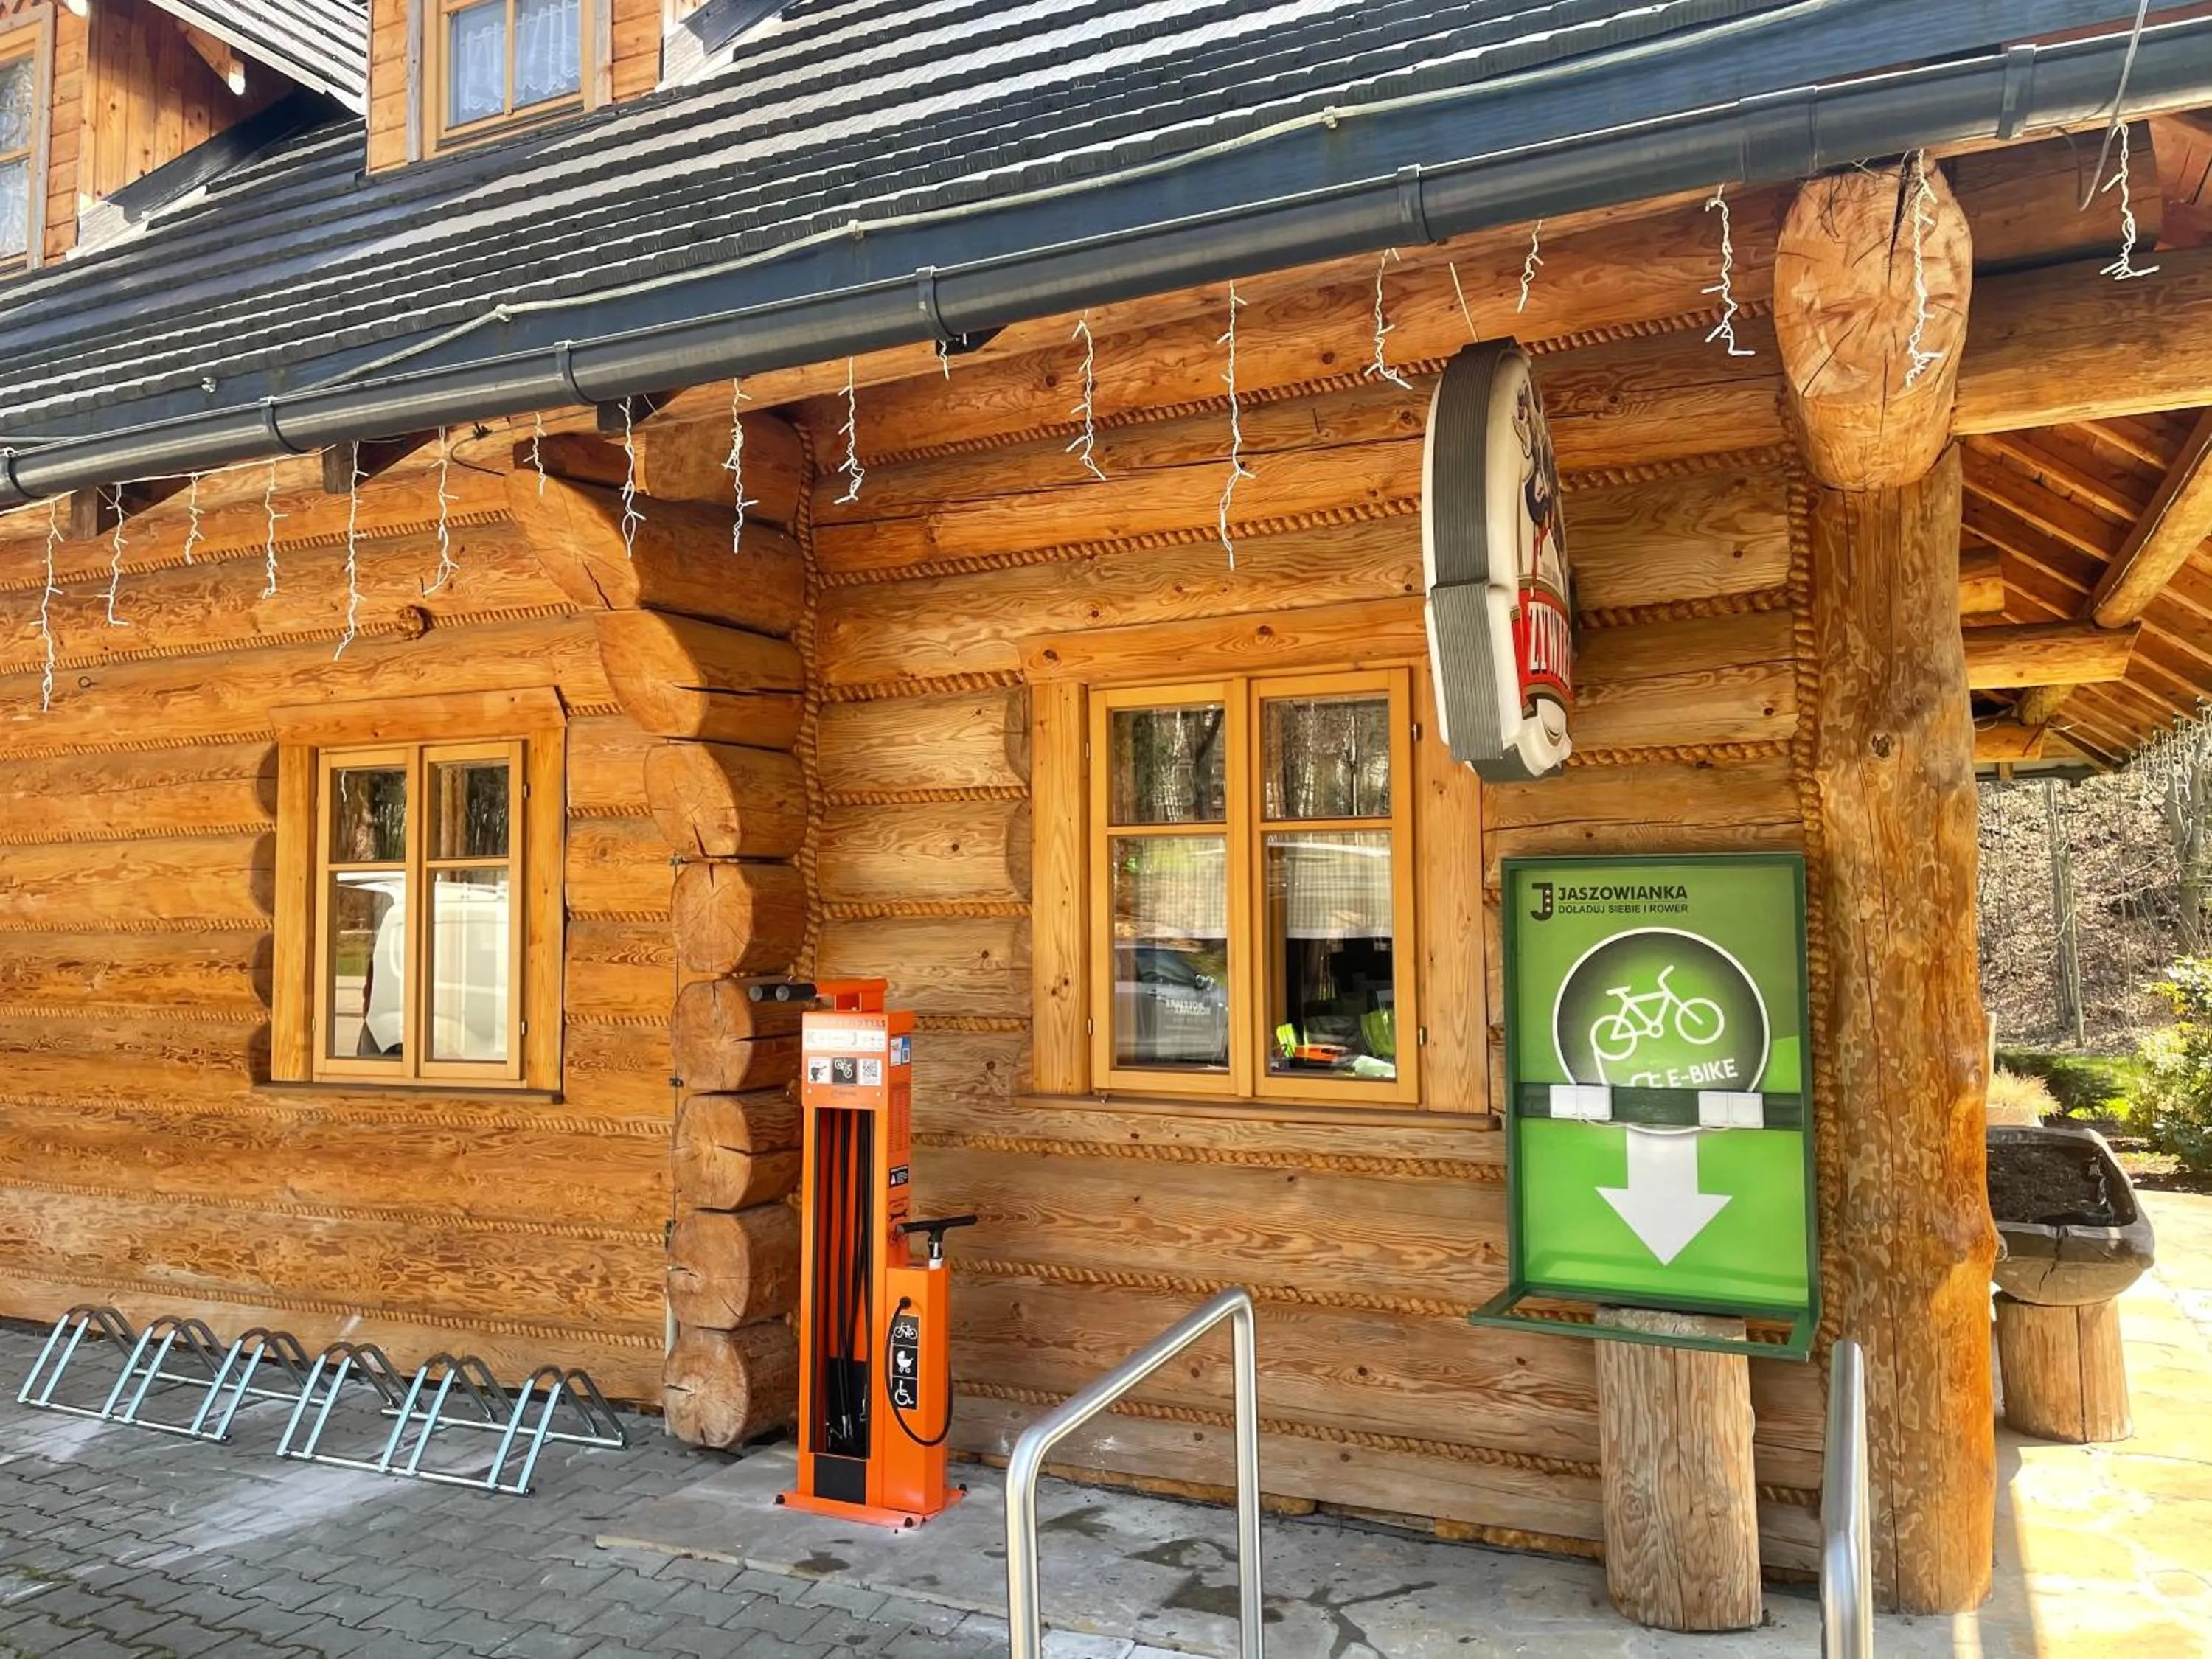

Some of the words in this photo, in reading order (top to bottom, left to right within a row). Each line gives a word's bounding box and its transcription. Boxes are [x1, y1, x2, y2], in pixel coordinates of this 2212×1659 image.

[1530, 883, 1554, 921] J
[1558, 886, 1688, 901] JASZOWIANKA
[1558, 905, 1605, 914] DOŁADUJ
[1608, 905, 1641, 914] SIEBIE
[1649, 904, 1688, 913] ROWER
[1666, 1058, 1739, 1088] E-BIKE
